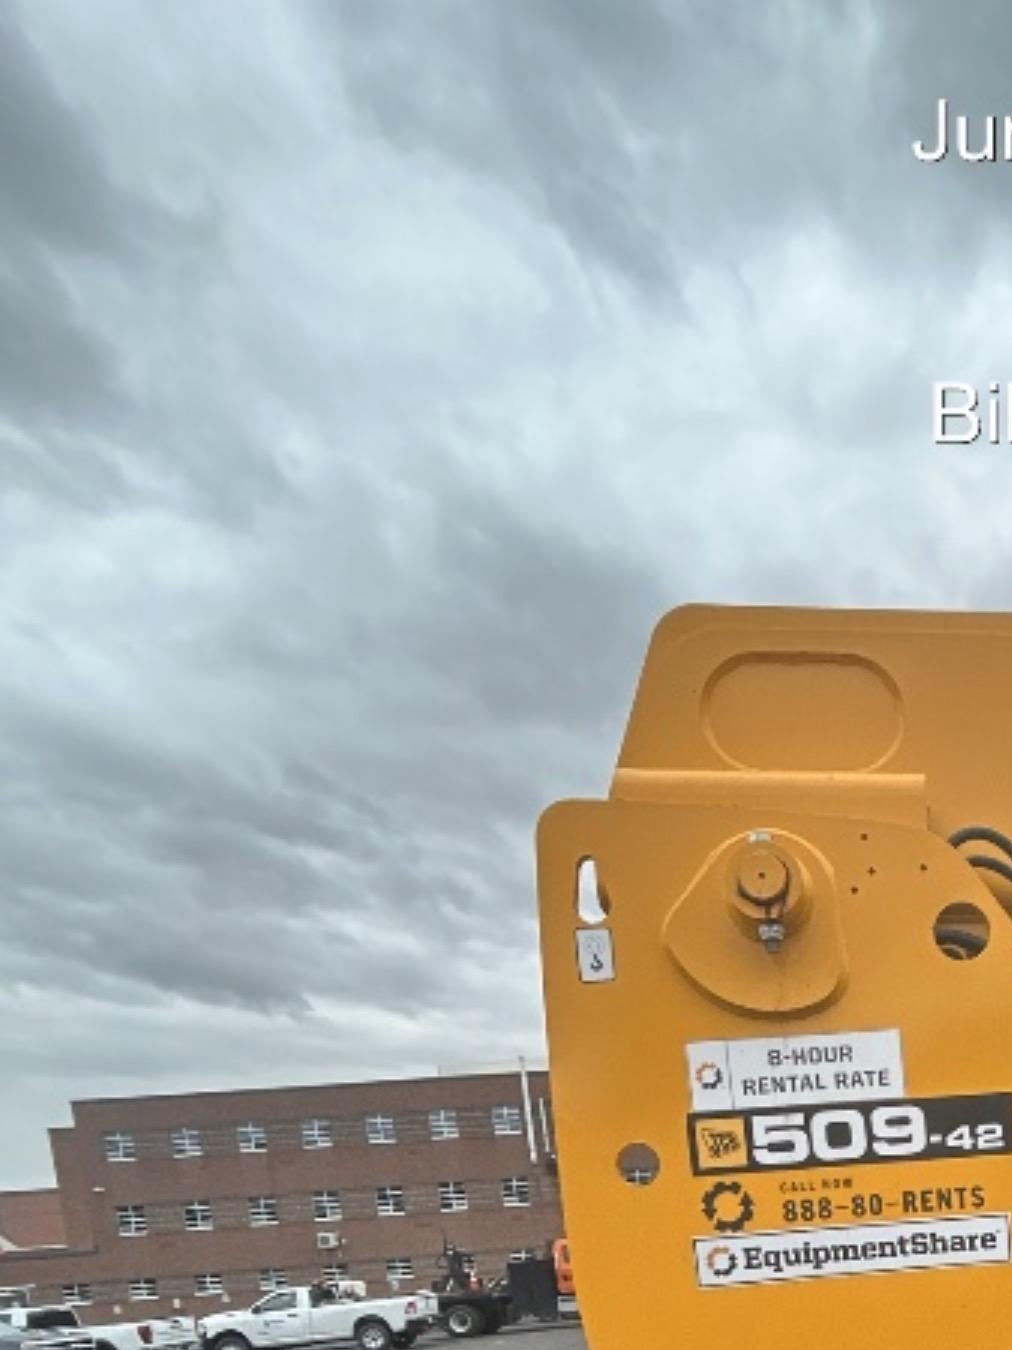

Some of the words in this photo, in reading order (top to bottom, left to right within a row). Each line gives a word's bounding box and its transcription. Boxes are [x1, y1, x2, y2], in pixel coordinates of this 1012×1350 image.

[767, 1045, 853, 1067] 8-HOUR
[742, 1075, 826, 1096] RENTAL
[835, 1068, 891, 1090] RATE
[751, 1105, 1006, 1165] 509-42
[779, 1181, 816, 1194] CALL
[782, 1186, 986, 1222] 888-80-RENTS
[742, 1230, 999, 1273] EquipmentShare
